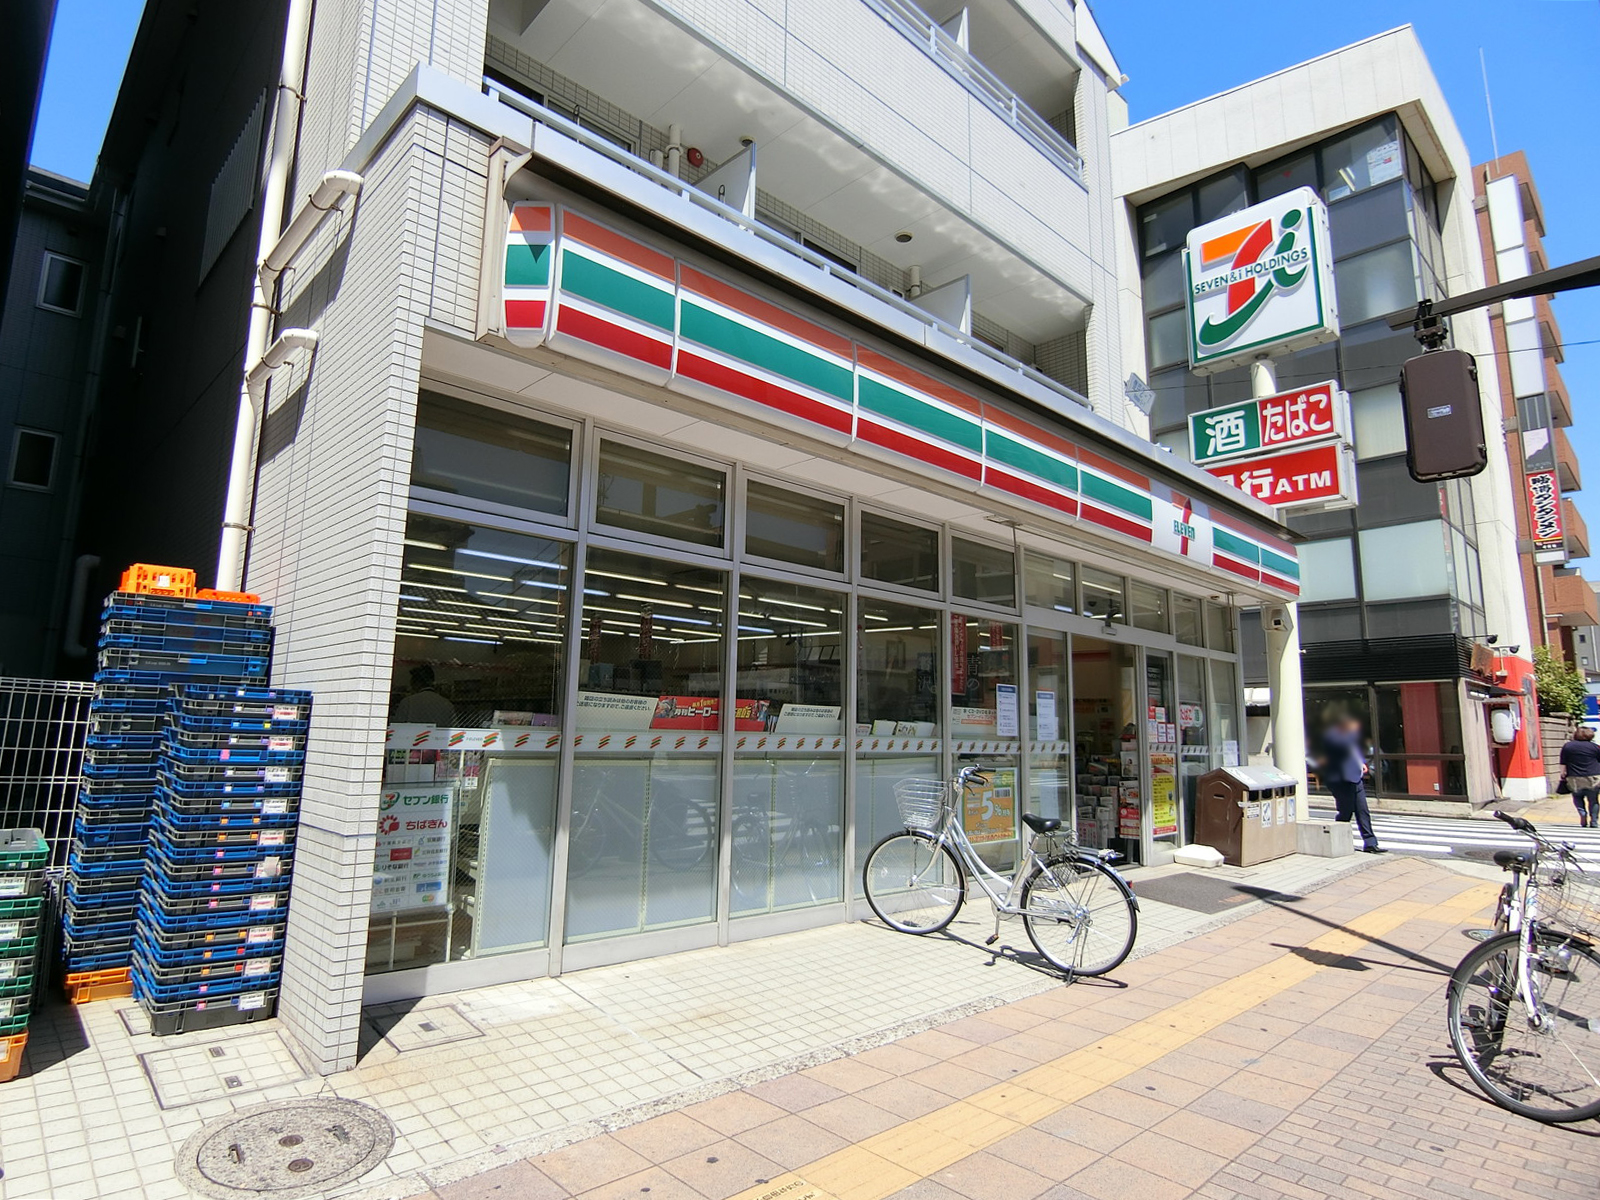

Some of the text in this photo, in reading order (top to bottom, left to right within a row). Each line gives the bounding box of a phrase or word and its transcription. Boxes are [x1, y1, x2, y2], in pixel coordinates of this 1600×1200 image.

[1245, 247, 1309, 278] HOLDINGS
[1204, 393, 1332, 456] 酒 たばこ
[403, 794, 449, 806] セブン銀行
[405, 819, 448, 831] ちばぎん
